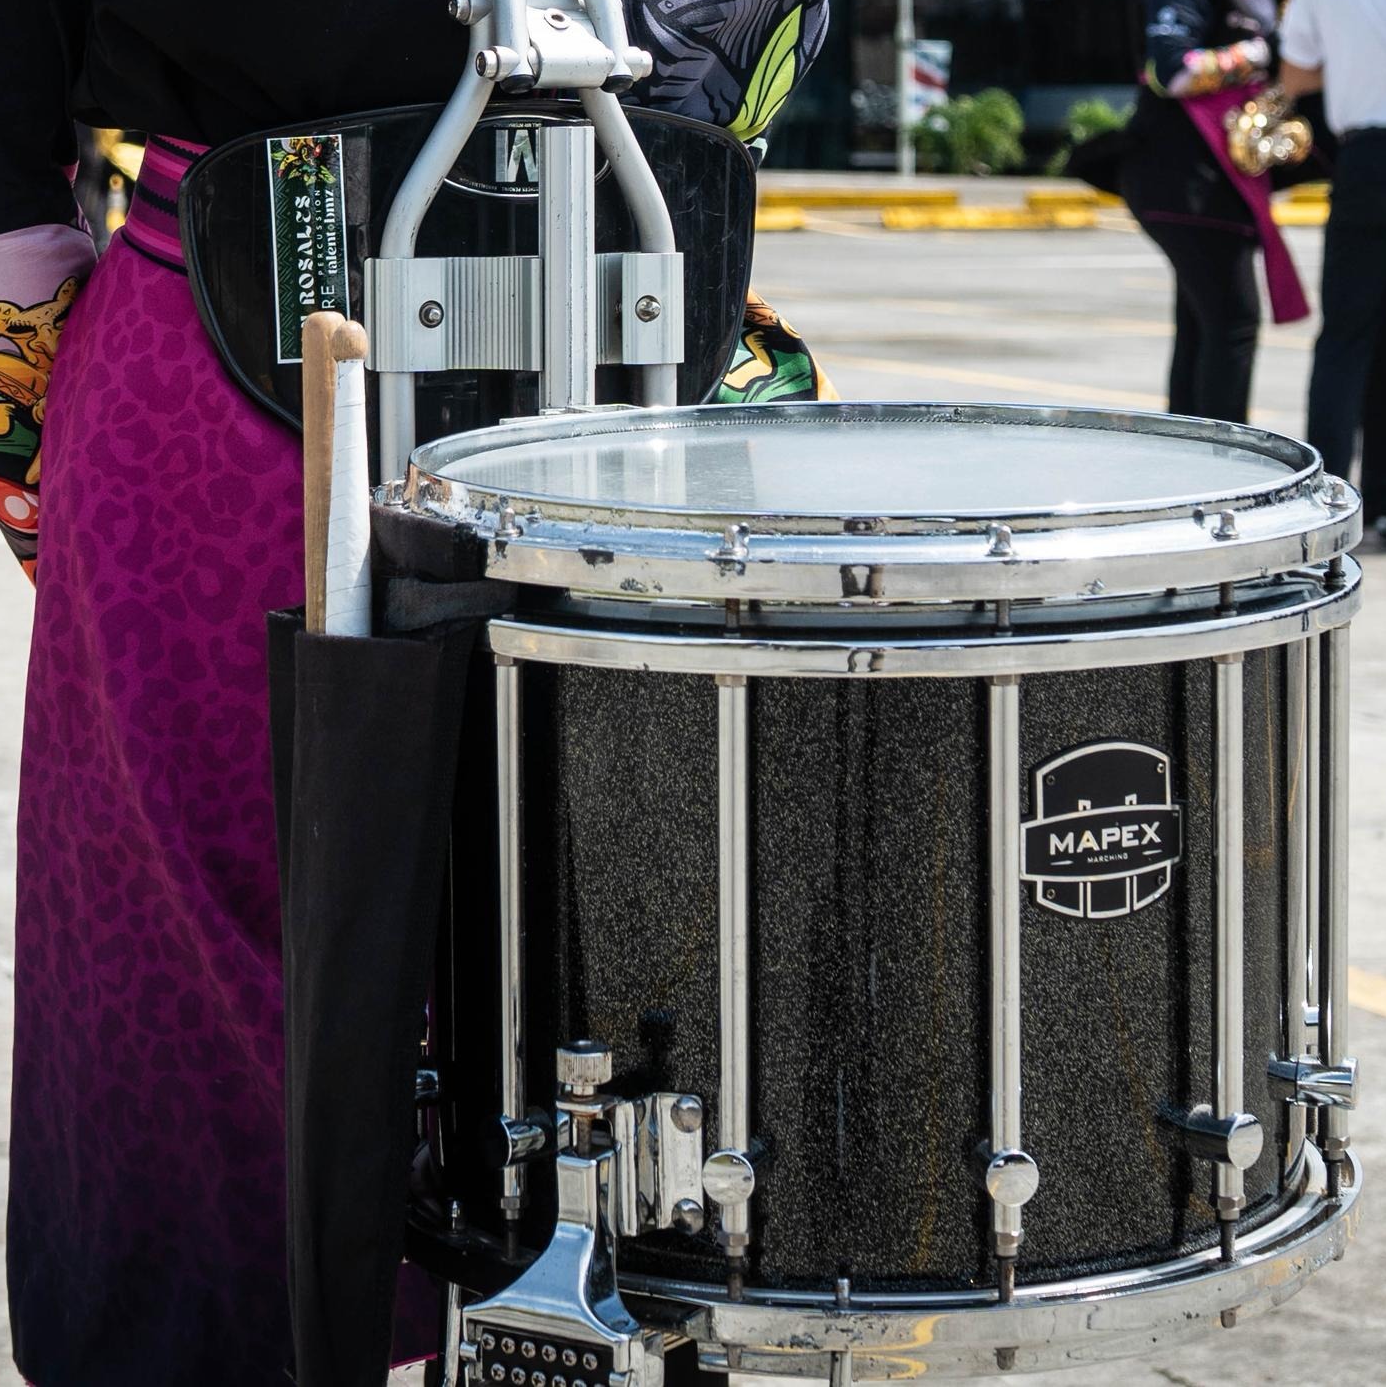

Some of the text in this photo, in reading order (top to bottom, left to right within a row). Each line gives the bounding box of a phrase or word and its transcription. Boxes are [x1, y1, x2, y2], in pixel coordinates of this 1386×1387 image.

[294, 195, 316, 305] ROSALES
[314, 189, 324, 276] PERCUSSION
[1049, 821, 1162, 855] MAPEX
[1087, 853, 1129, 863] MARCHING
